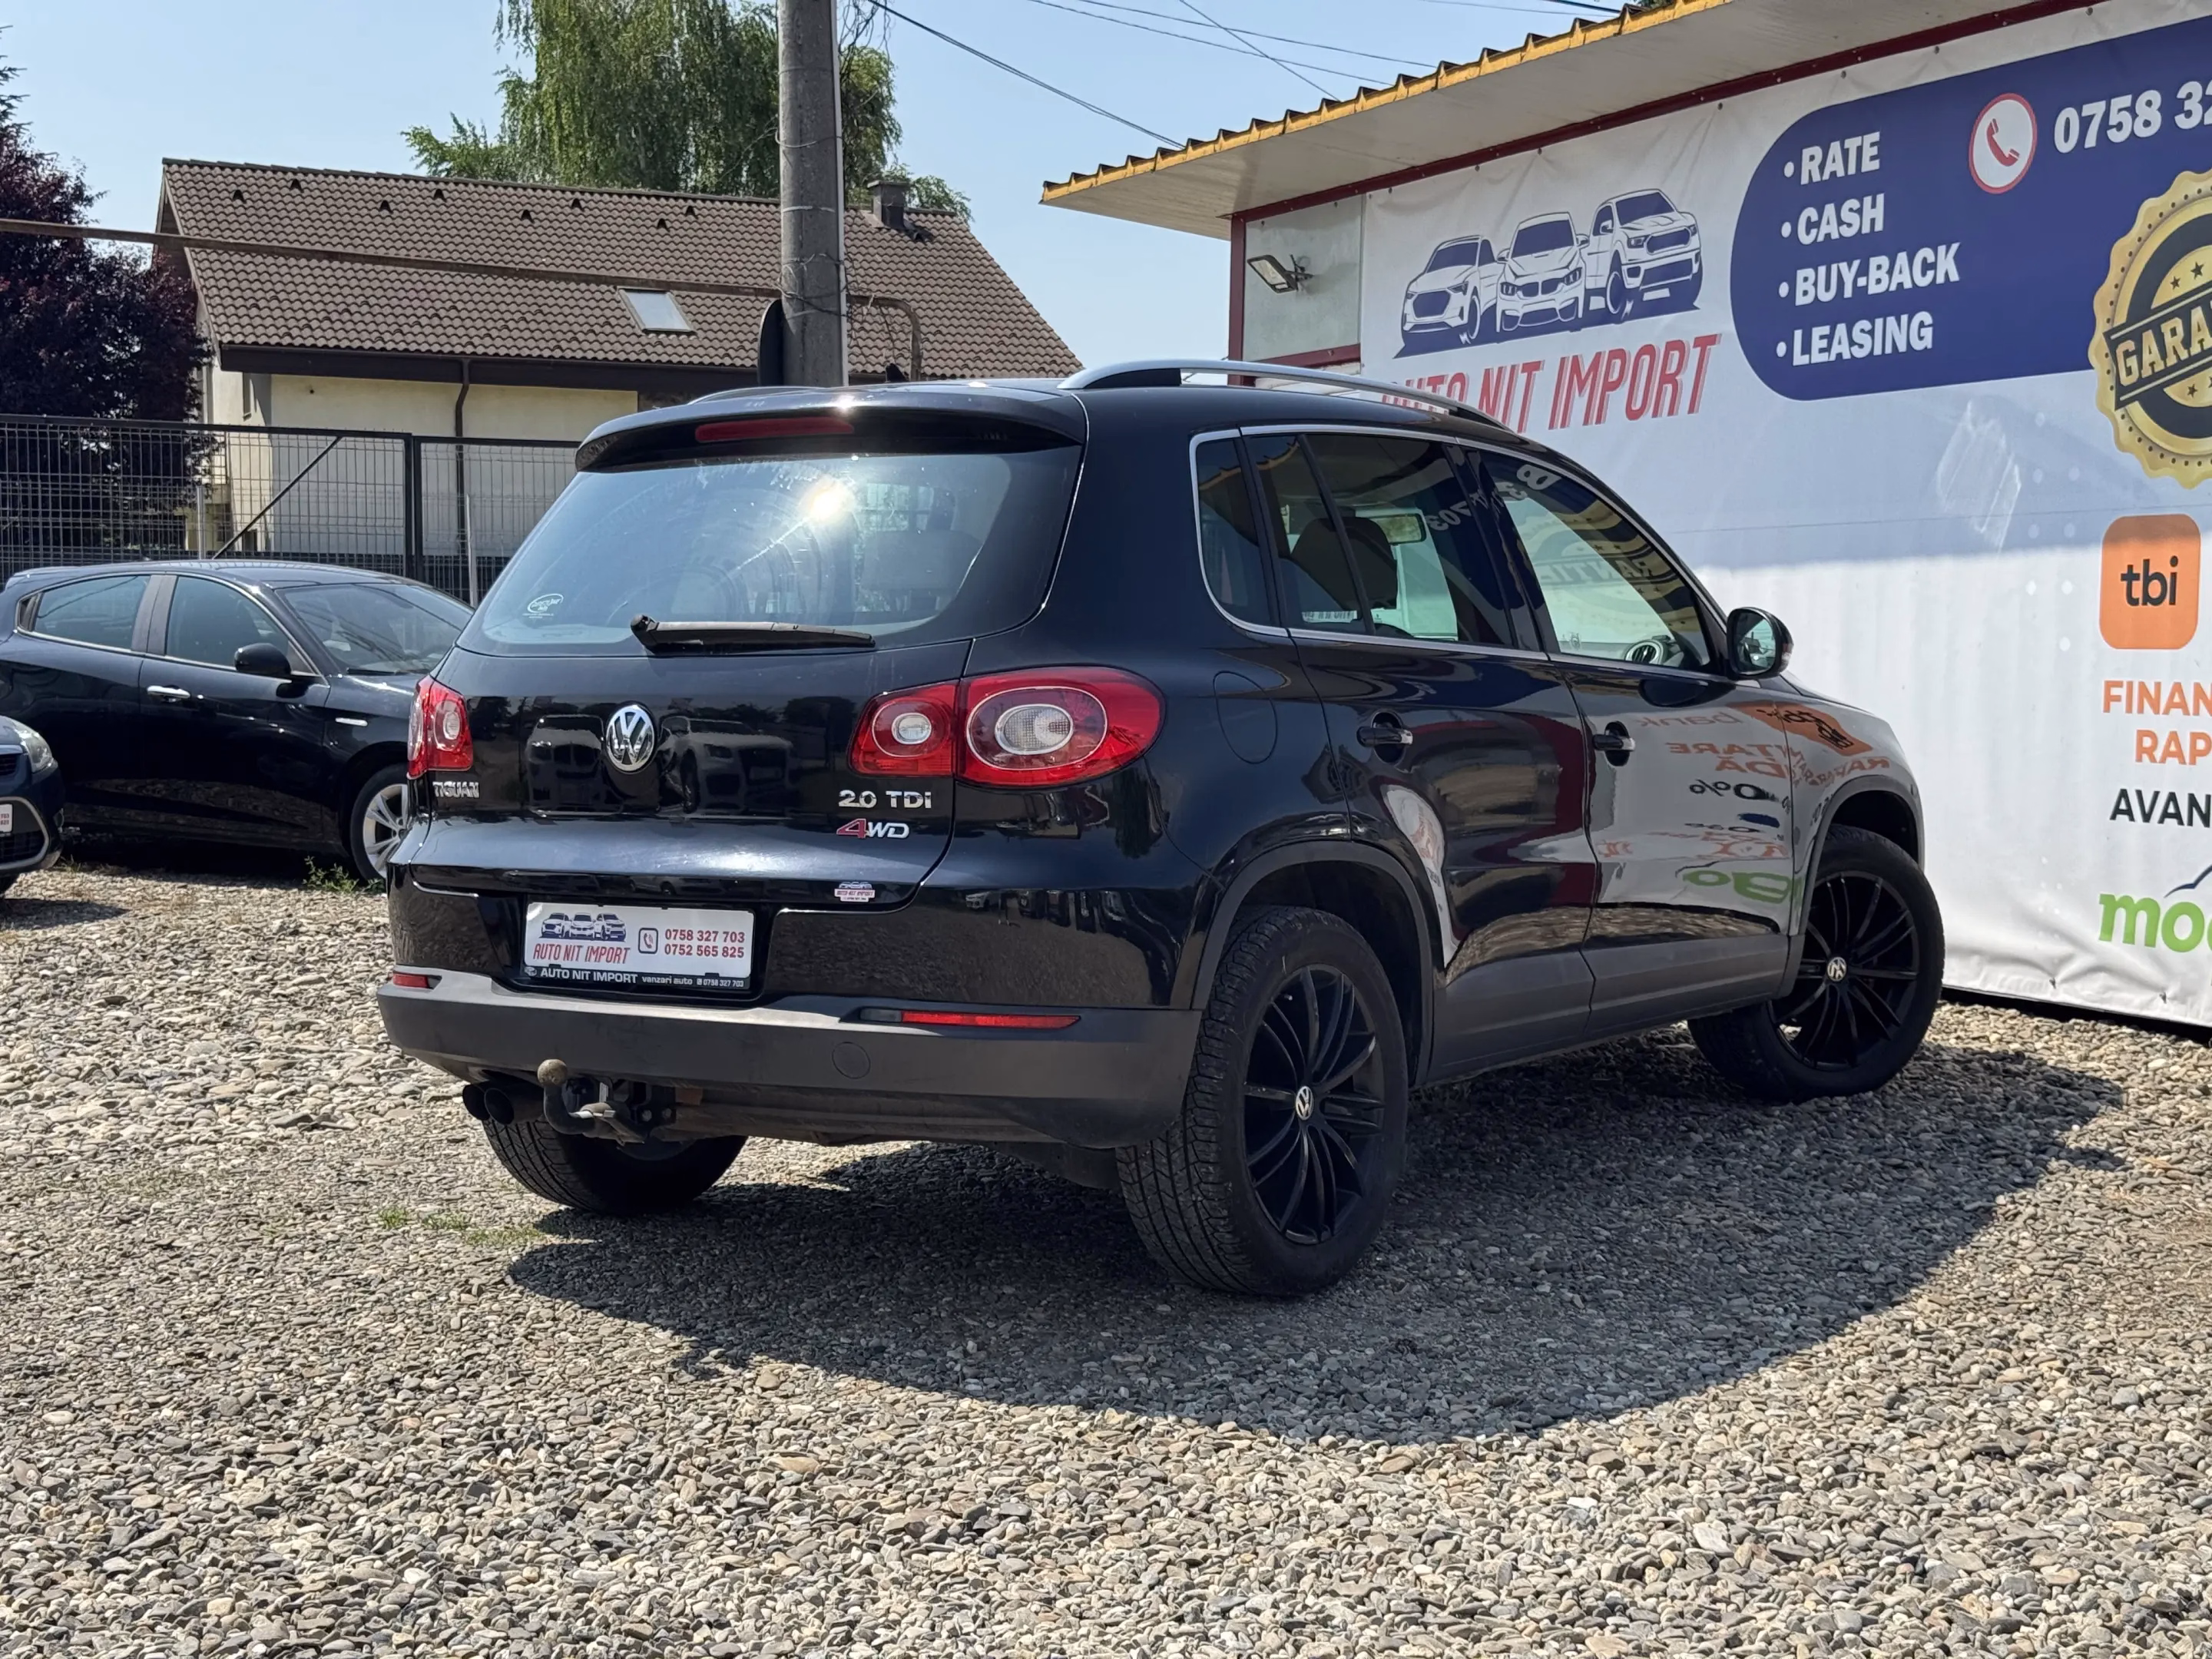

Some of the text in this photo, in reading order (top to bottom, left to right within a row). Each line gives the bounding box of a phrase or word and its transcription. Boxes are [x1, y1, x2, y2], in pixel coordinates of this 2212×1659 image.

[2054, 89, 2162, 154] 0758
[1800, 131, 1881, 185] RATE
[1796, 193, 1885, 245] CASH
[1794, 242, 1960, 306] BUY-BACK
[1792, 311, 1934, 366] LEASING
[2115, 300, 2212, 386] GARA
[1478, 359, 1545, 434] NIT
[1548, 333, 1721, 431] IMPORT
[2120, 555, 2179, 607] tbi
[2102, 680, 2212, 717] FINAN
[2134, 729, 2212, 766] RAP
[836, 818, 909, 839] 4WD
[2109, 788, 2212, 829] AVAN
[664, 929, 745, 943] 0758 327 703
[2098, 892, 2212, 953] mo
[532, 942, 631, 965] AUTO NIT IMPORT
[540, 967, 570, 979] AUTO
[572, 969, 591, 981] NIT
[593, 972, 638, 984] IMPORT
[664, 943, 745, 959] 0752 565 825
